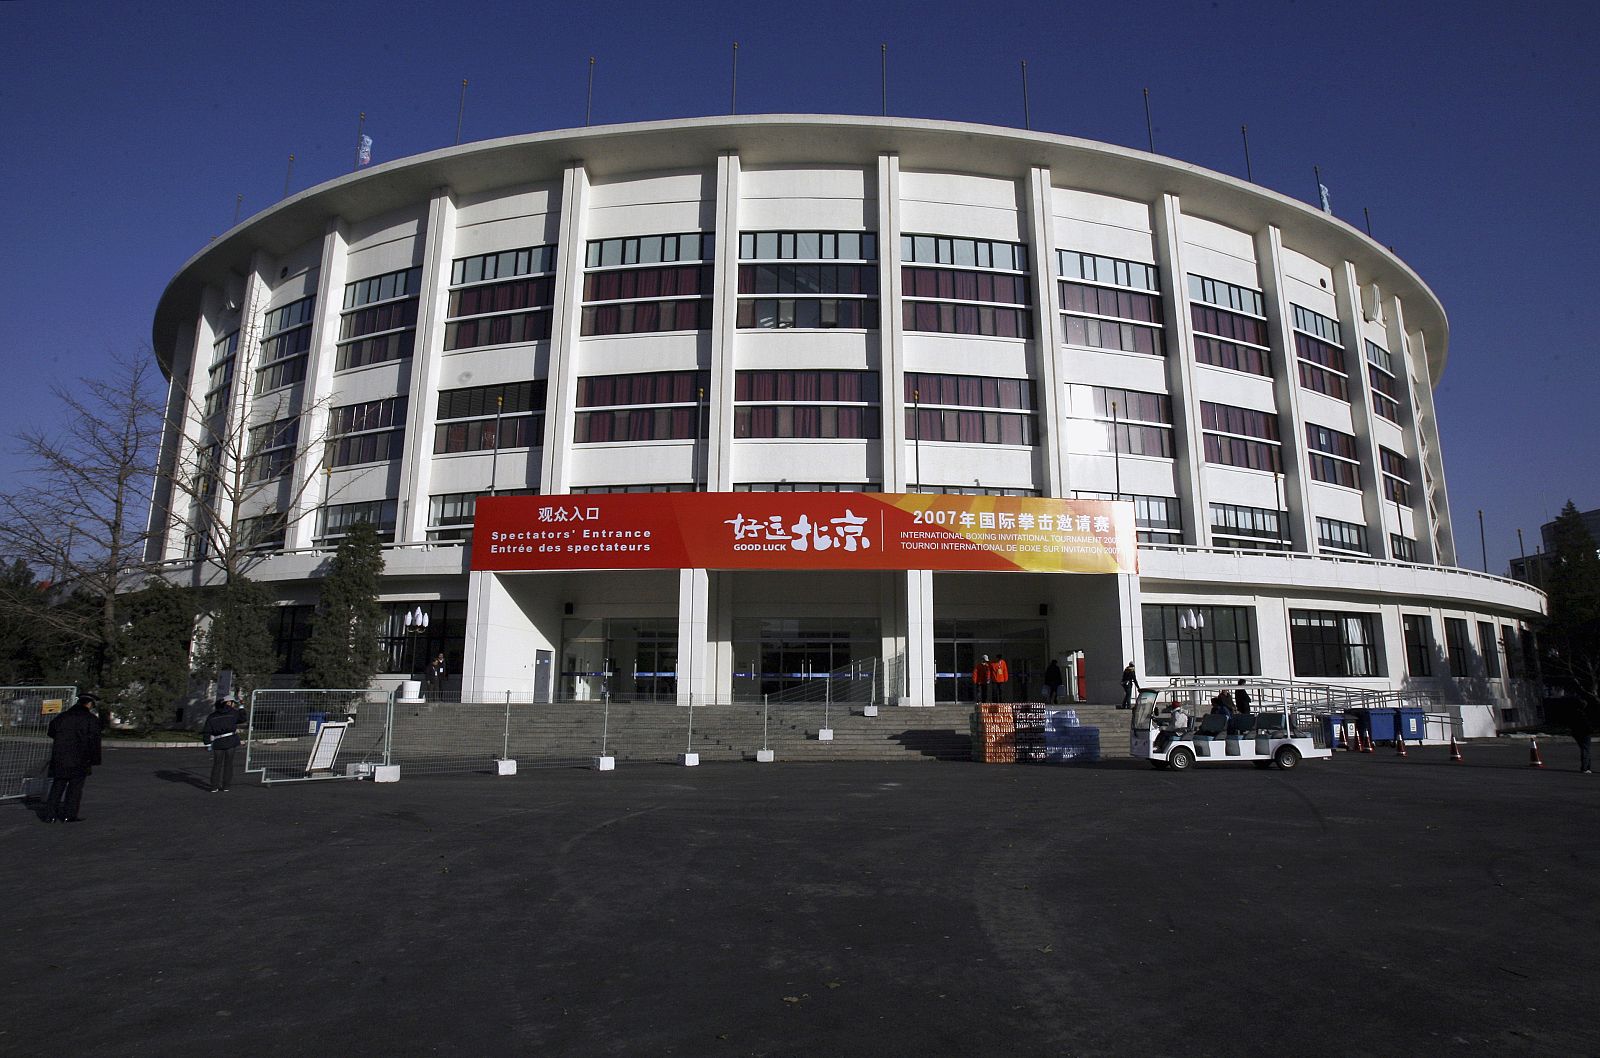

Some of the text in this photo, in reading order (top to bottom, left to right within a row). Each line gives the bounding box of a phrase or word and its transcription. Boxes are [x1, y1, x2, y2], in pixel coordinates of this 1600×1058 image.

[538, 506, 600, 523] 观众入口
[913, 510, 1111, 533] 2007年国际拳击邀请赛
[582, 529, 651, 539] Entrance
[724, 509, 871, 551] 好运北京
[900, 531, 964, 540] INTERNATIONAL
[965, 533, 997, 541] BOXING
[998, 533, 1049, 542] INVITATIONAL
[1050, 535, 1102, 544] TOURNAMENT
[490, 543, 651, 554] Entrée des spectateurs
[733, 543, 787, 551] GOOD LUCK
[900, 541, 939, 550] TOURNOI
[941, 542, 1004, 551] INTERNATIONAL
[1006, 544, 1018, 552] DE
[1019, 544, 1041, 553] BOXE
[1042, 545, 1061, 553] SUR
[1061, 545, 1102, 554] INVITATION
